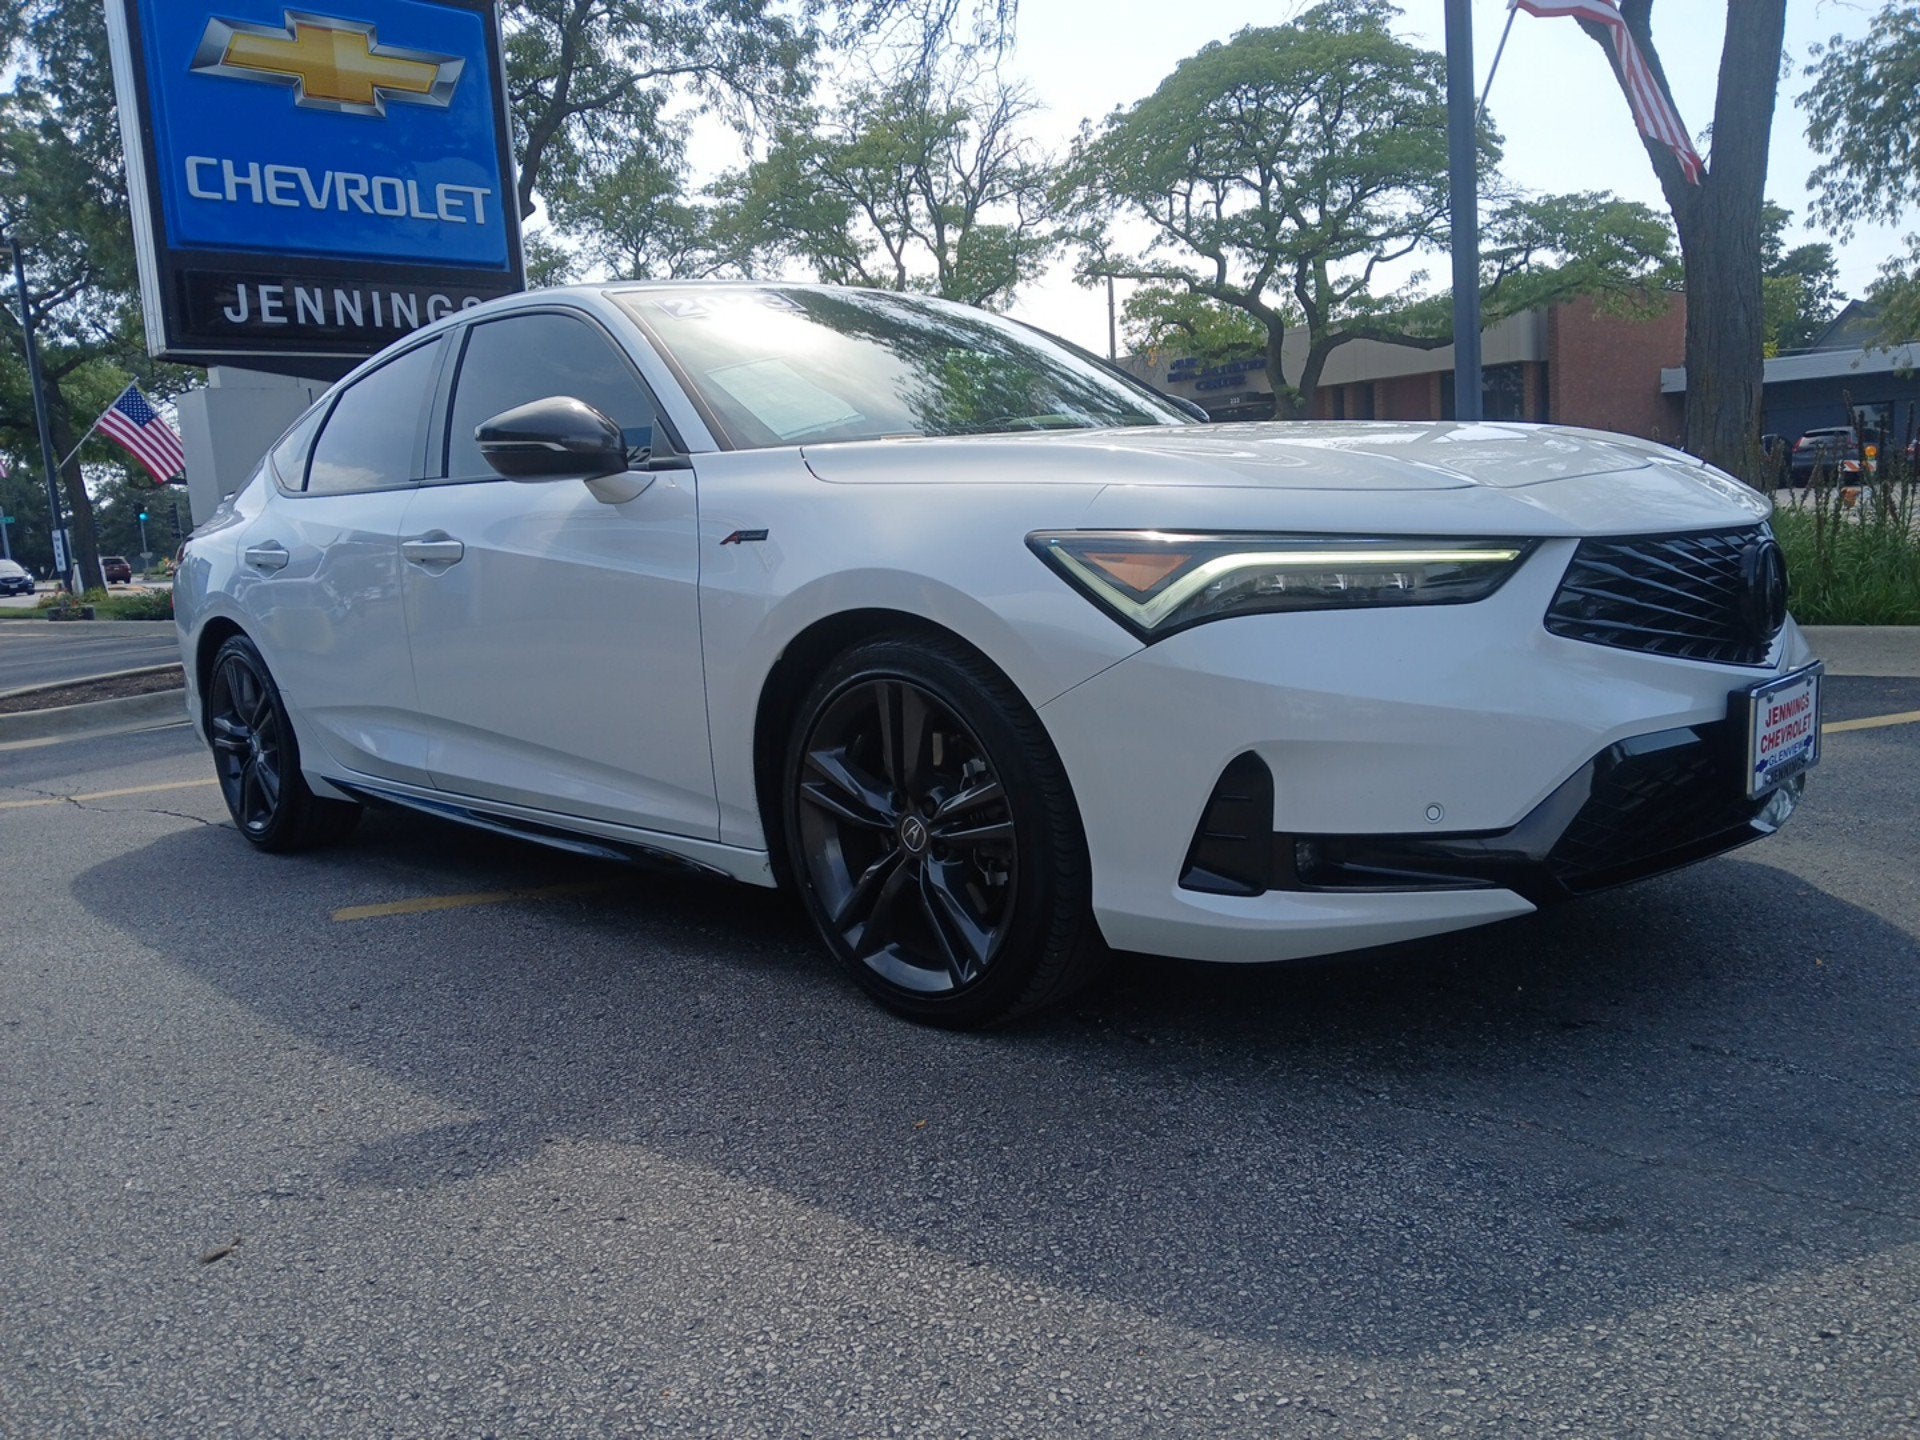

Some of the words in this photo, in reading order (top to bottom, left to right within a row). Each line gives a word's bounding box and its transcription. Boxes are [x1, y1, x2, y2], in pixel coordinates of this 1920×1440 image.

[185, 155, 491, 225] CHEVROLET
[1765, 692, 1810, 728] JENNINGS
[1760, 712, 1812, 754] CHEVROLET
